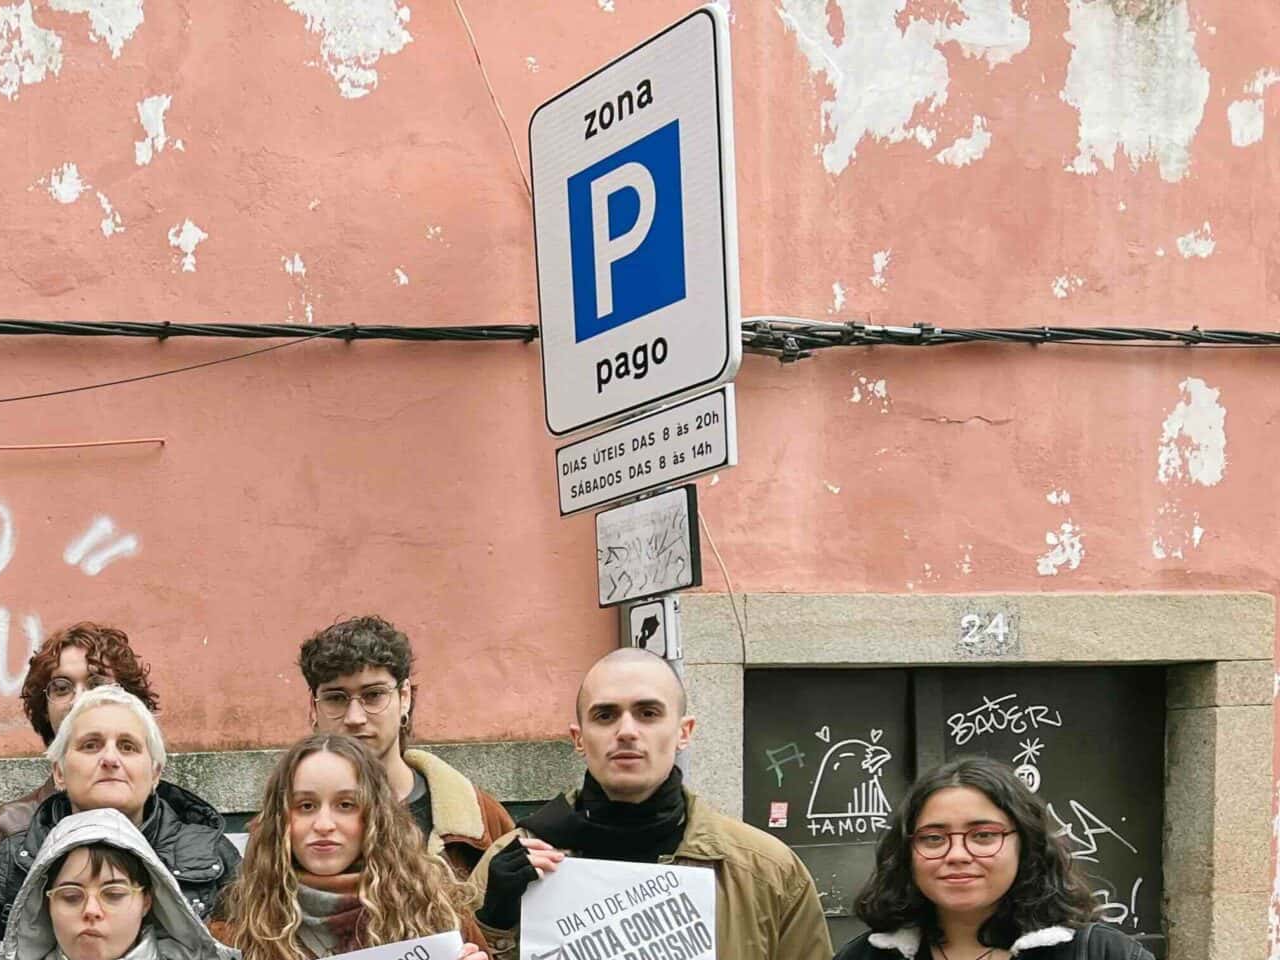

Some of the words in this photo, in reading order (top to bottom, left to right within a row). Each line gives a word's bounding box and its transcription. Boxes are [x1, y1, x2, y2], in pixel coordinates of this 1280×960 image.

[583, 79, 653, 140] zona
[590, 161, 656, 319] P
[596, 337, 668, 393] pago
[562, 457, 587, 477] DIAS
[593, 443, 625, 466] ÚTEIS
[632, 434, 655, 453] DAS
[662, 427, 670, 441] 8
[676, 422, 689, 438] às
[695, 411, 719, 430] 20h
[570, 470, 622, 499] SÁBADOS
[628, 460, 652, 480] DAS
[659, 454, 667, 469] 8
[672, 449, 685, 465] às
[691, 441, 712, 460] 14h
[960, 611, 1009, 643] 24
[556, 913, 586, 937] DIA
[583, 903, 605, 925] 10
[604, 893, 628, 915] DE
[624, 871, 680, 907] MARÇO
[620, 892, 701, 947] CONTRA
